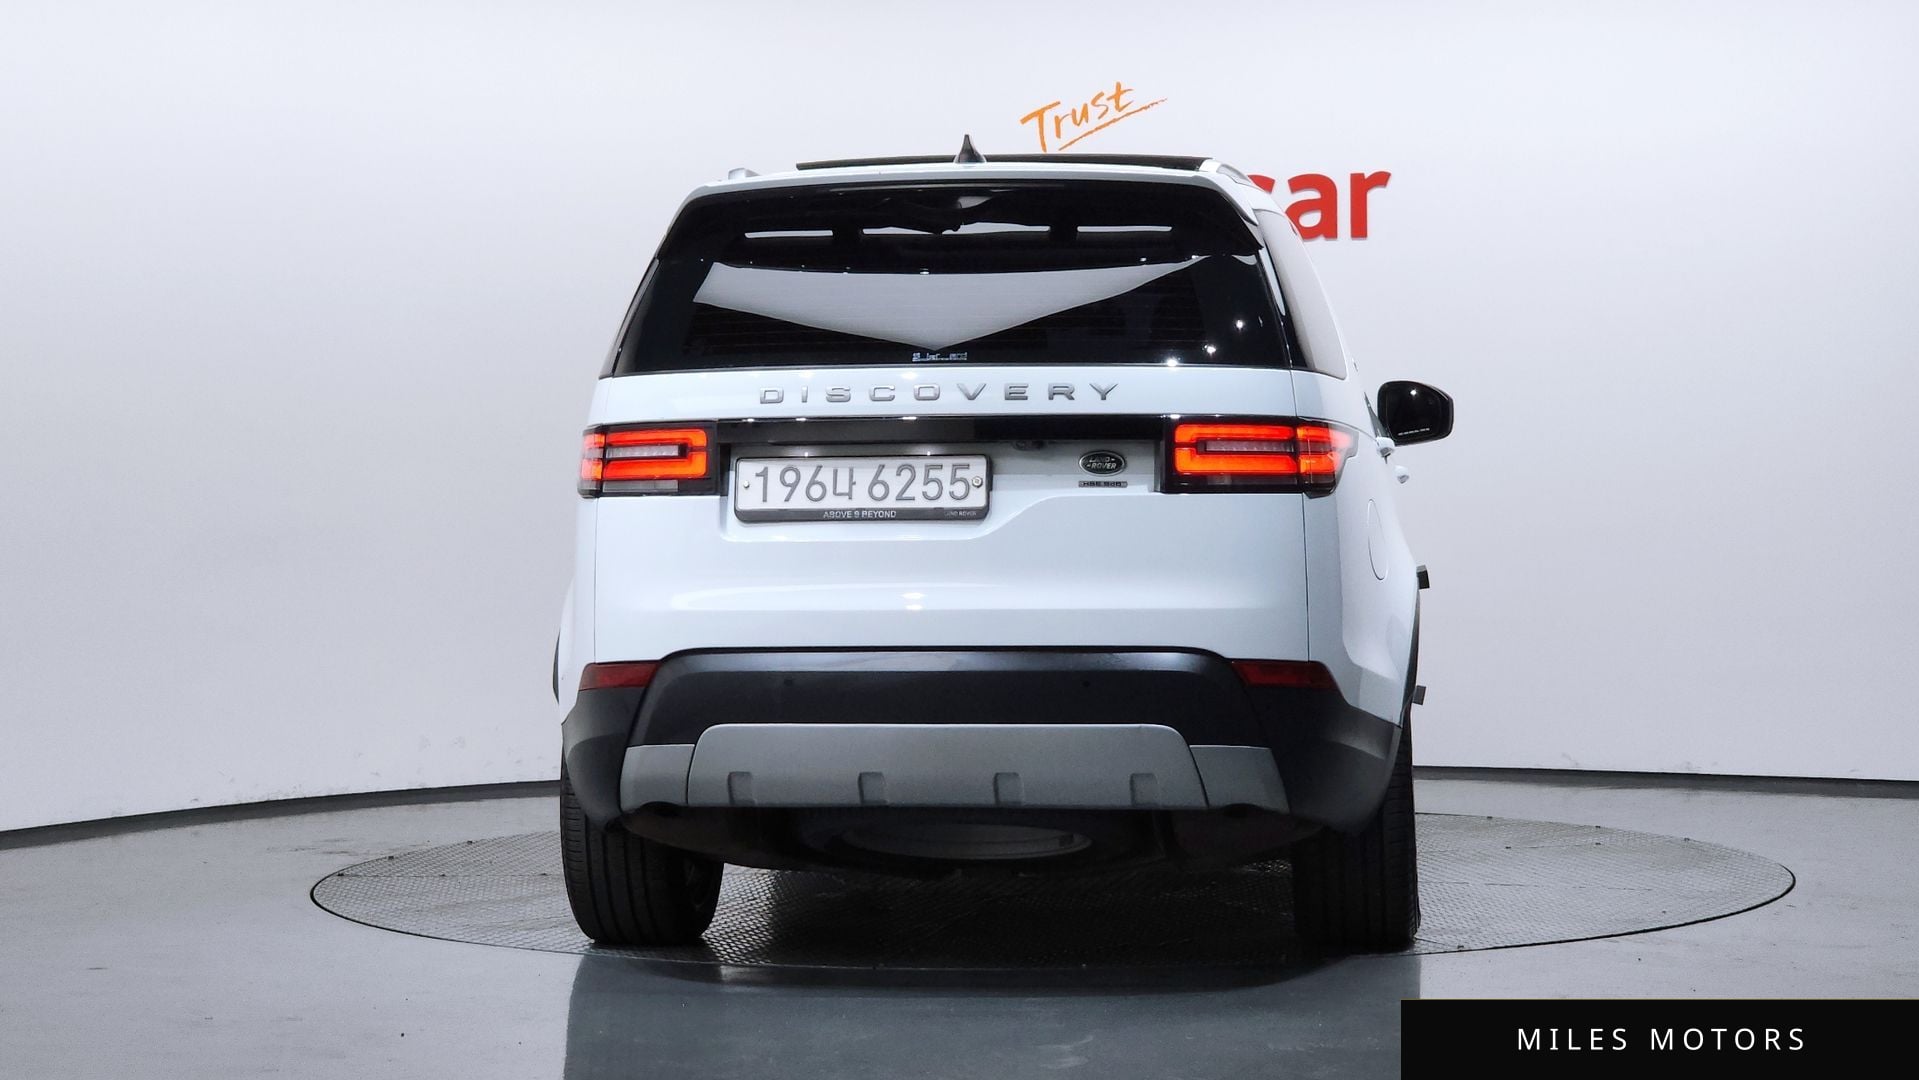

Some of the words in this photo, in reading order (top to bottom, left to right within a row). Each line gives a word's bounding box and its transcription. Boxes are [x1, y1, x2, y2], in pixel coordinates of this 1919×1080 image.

[1020, 82, 1134, 153] Trust
[759, 382, 1119, 404] DISCOVERY
[1091, 462, 1117, 470] ROVER
[868, 463, 971, 502] 6255
[823, 510, 853, 519] ABOVE
[861, 510, 897, 518] BEYOND
